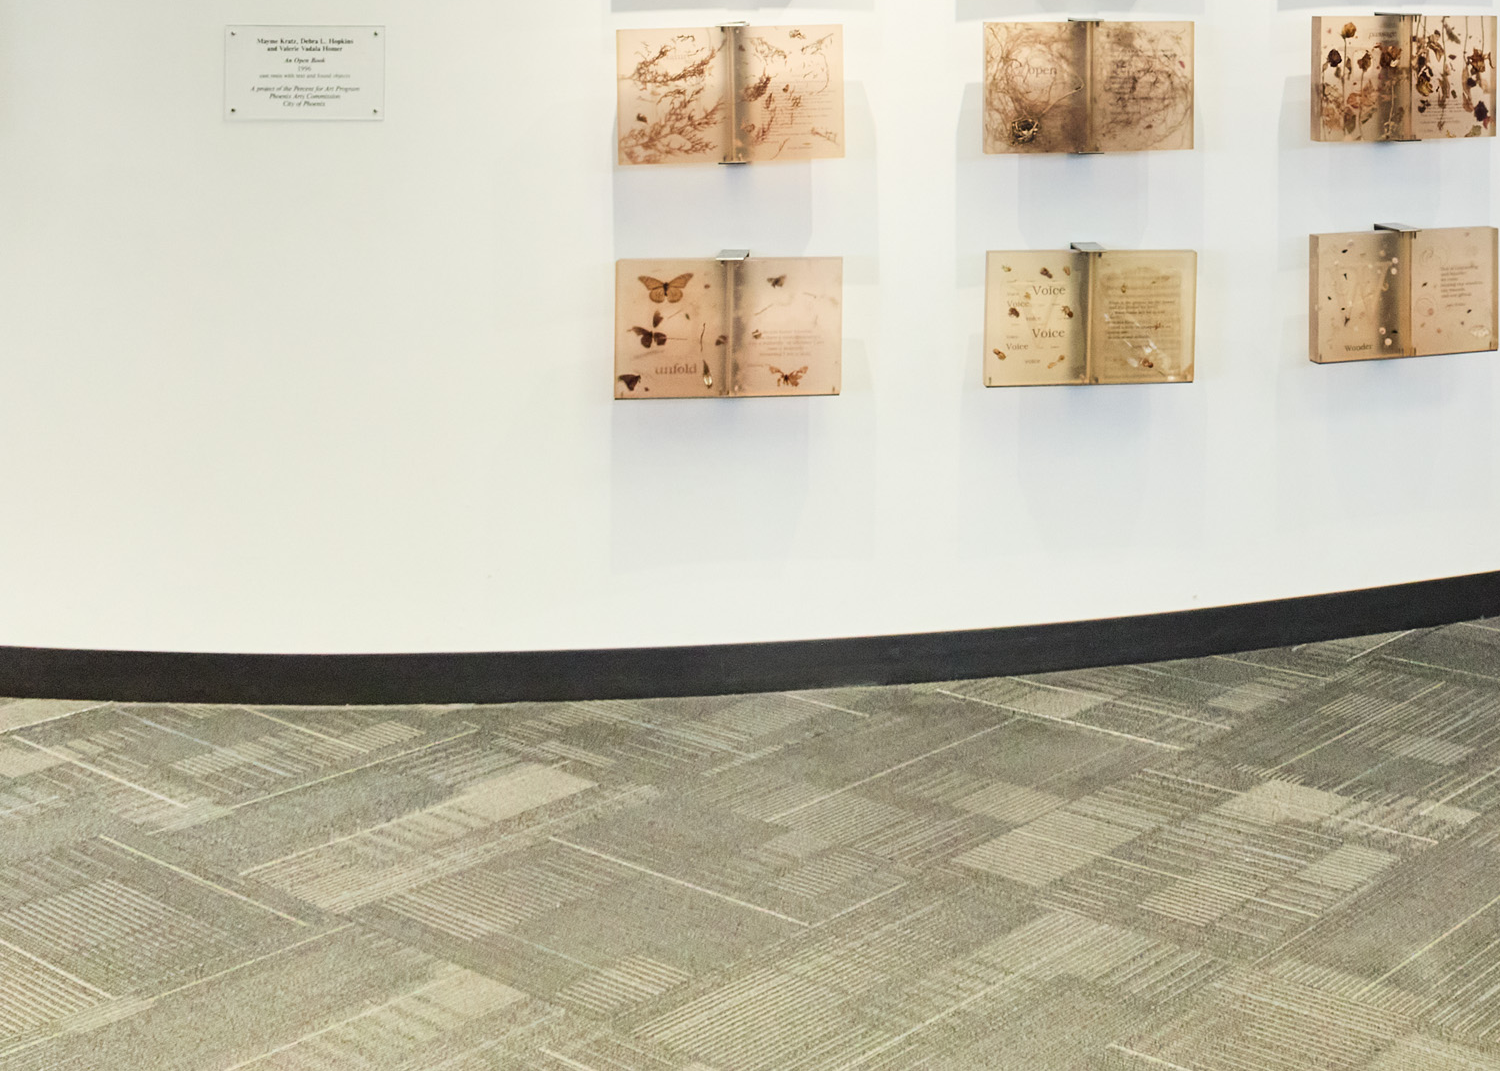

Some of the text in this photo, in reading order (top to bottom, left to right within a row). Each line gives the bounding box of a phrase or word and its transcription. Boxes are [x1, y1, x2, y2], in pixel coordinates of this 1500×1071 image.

[1029, 67, 1057, 78] open
[1033, 285, 1066, 295] Voice
[1032, 328, 1065, 338] Voice
[1344, 343, 1373, 352] Wonder
[655, 363, 697, 375] unfold
